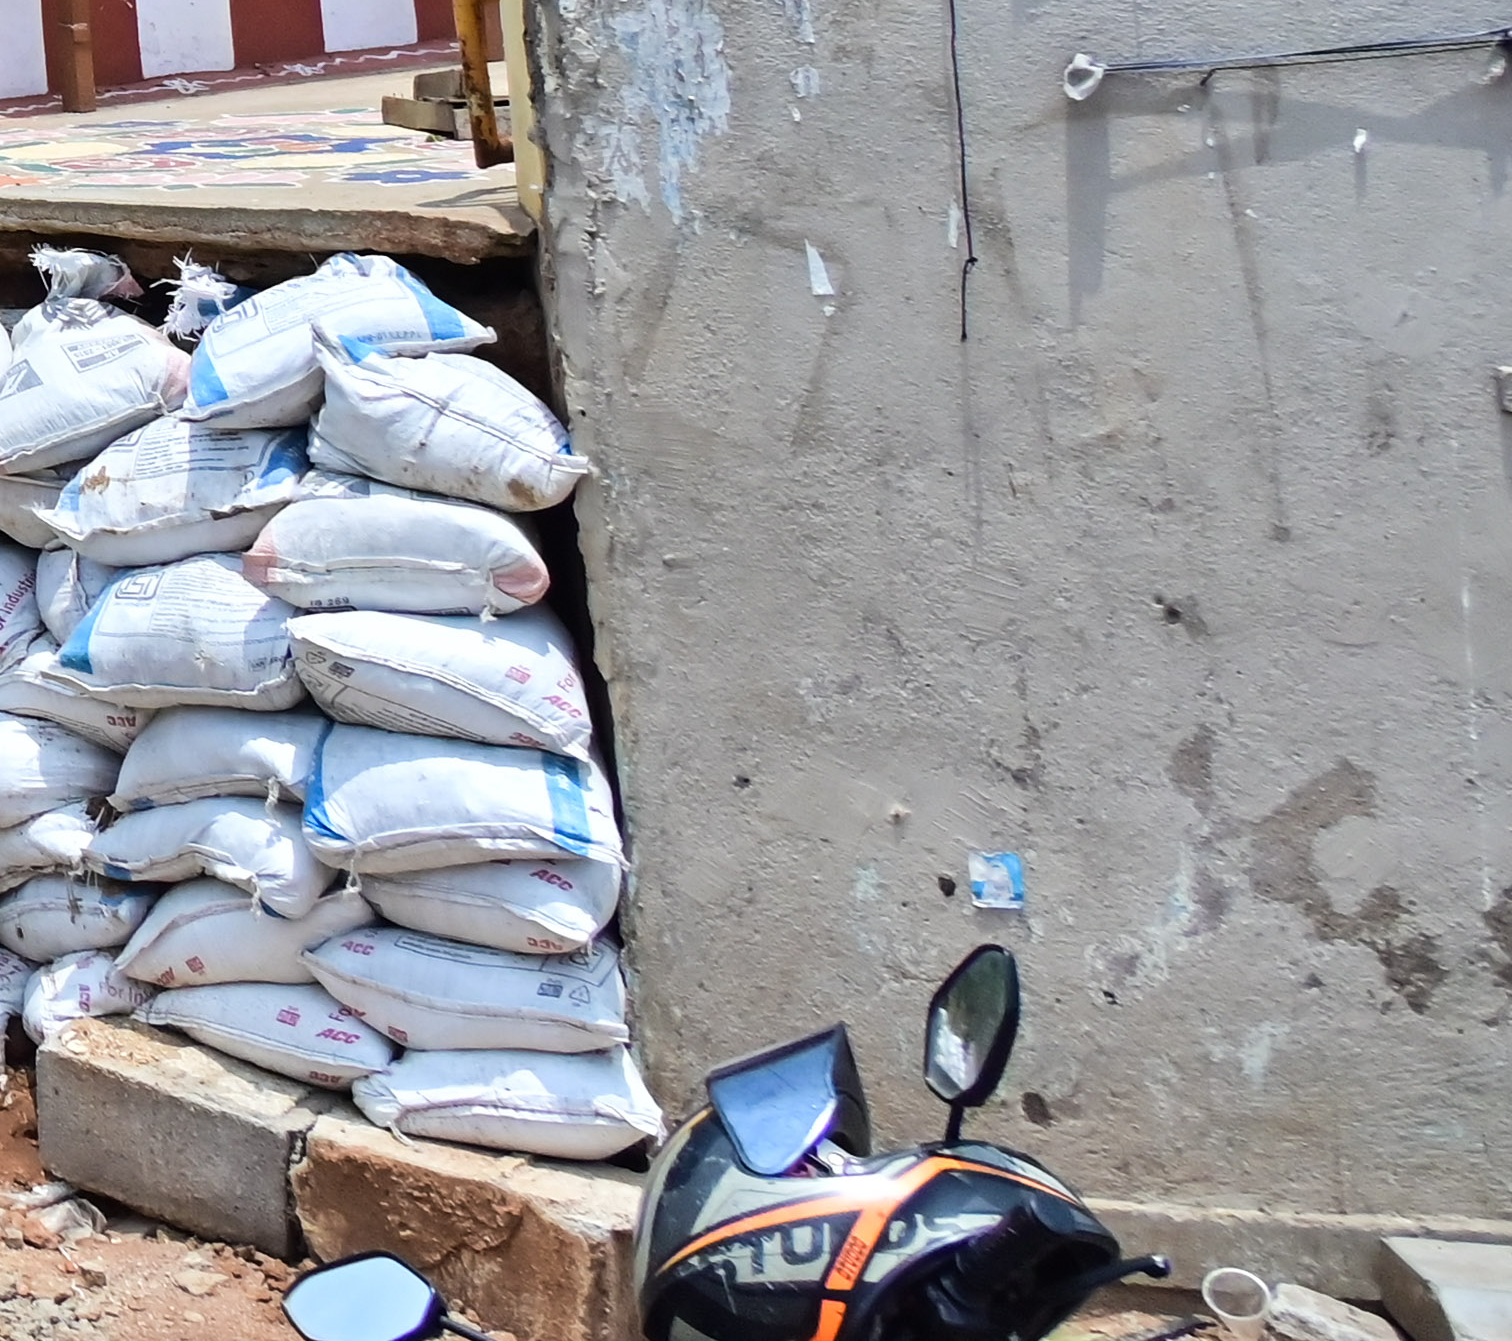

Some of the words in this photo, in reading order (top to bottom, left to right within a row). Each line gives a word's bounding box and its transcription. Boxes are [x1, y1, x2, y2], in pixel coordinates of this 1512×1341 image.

[541, 693, 583, 720] ACC
[529, 867, 573, 891] ACC
[341, 941, 375, 957] ACC
[316, 1027, 361, 1045] ACC
